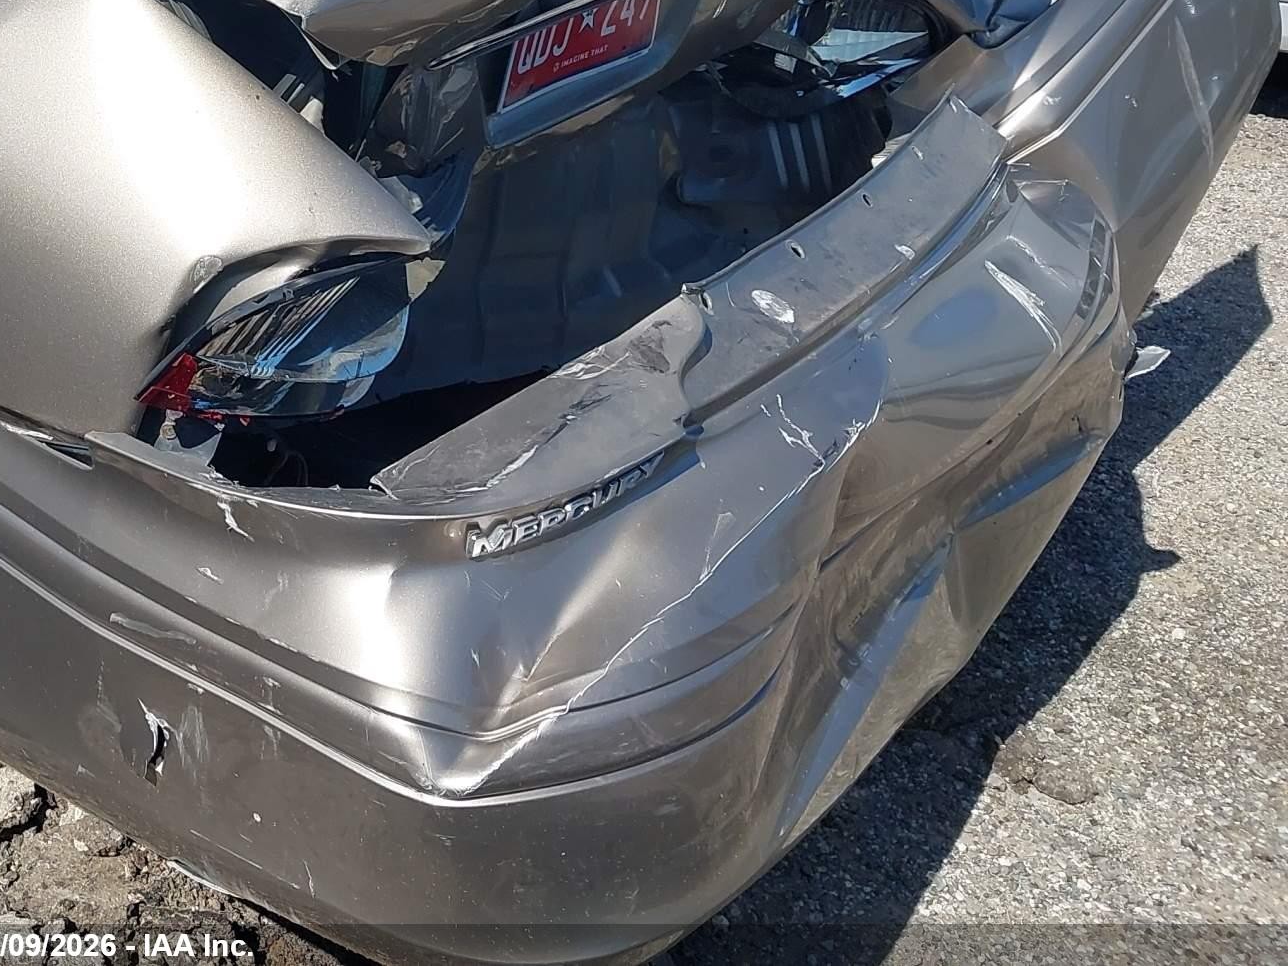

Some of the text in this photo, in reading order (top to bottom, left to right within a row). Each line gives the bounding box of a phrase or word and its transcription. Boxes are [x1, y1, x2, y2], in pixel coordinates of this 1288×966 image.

[560, 44, 609, 69] IMAGINE THAT
[465, 450, 665, 560] MERCURY
